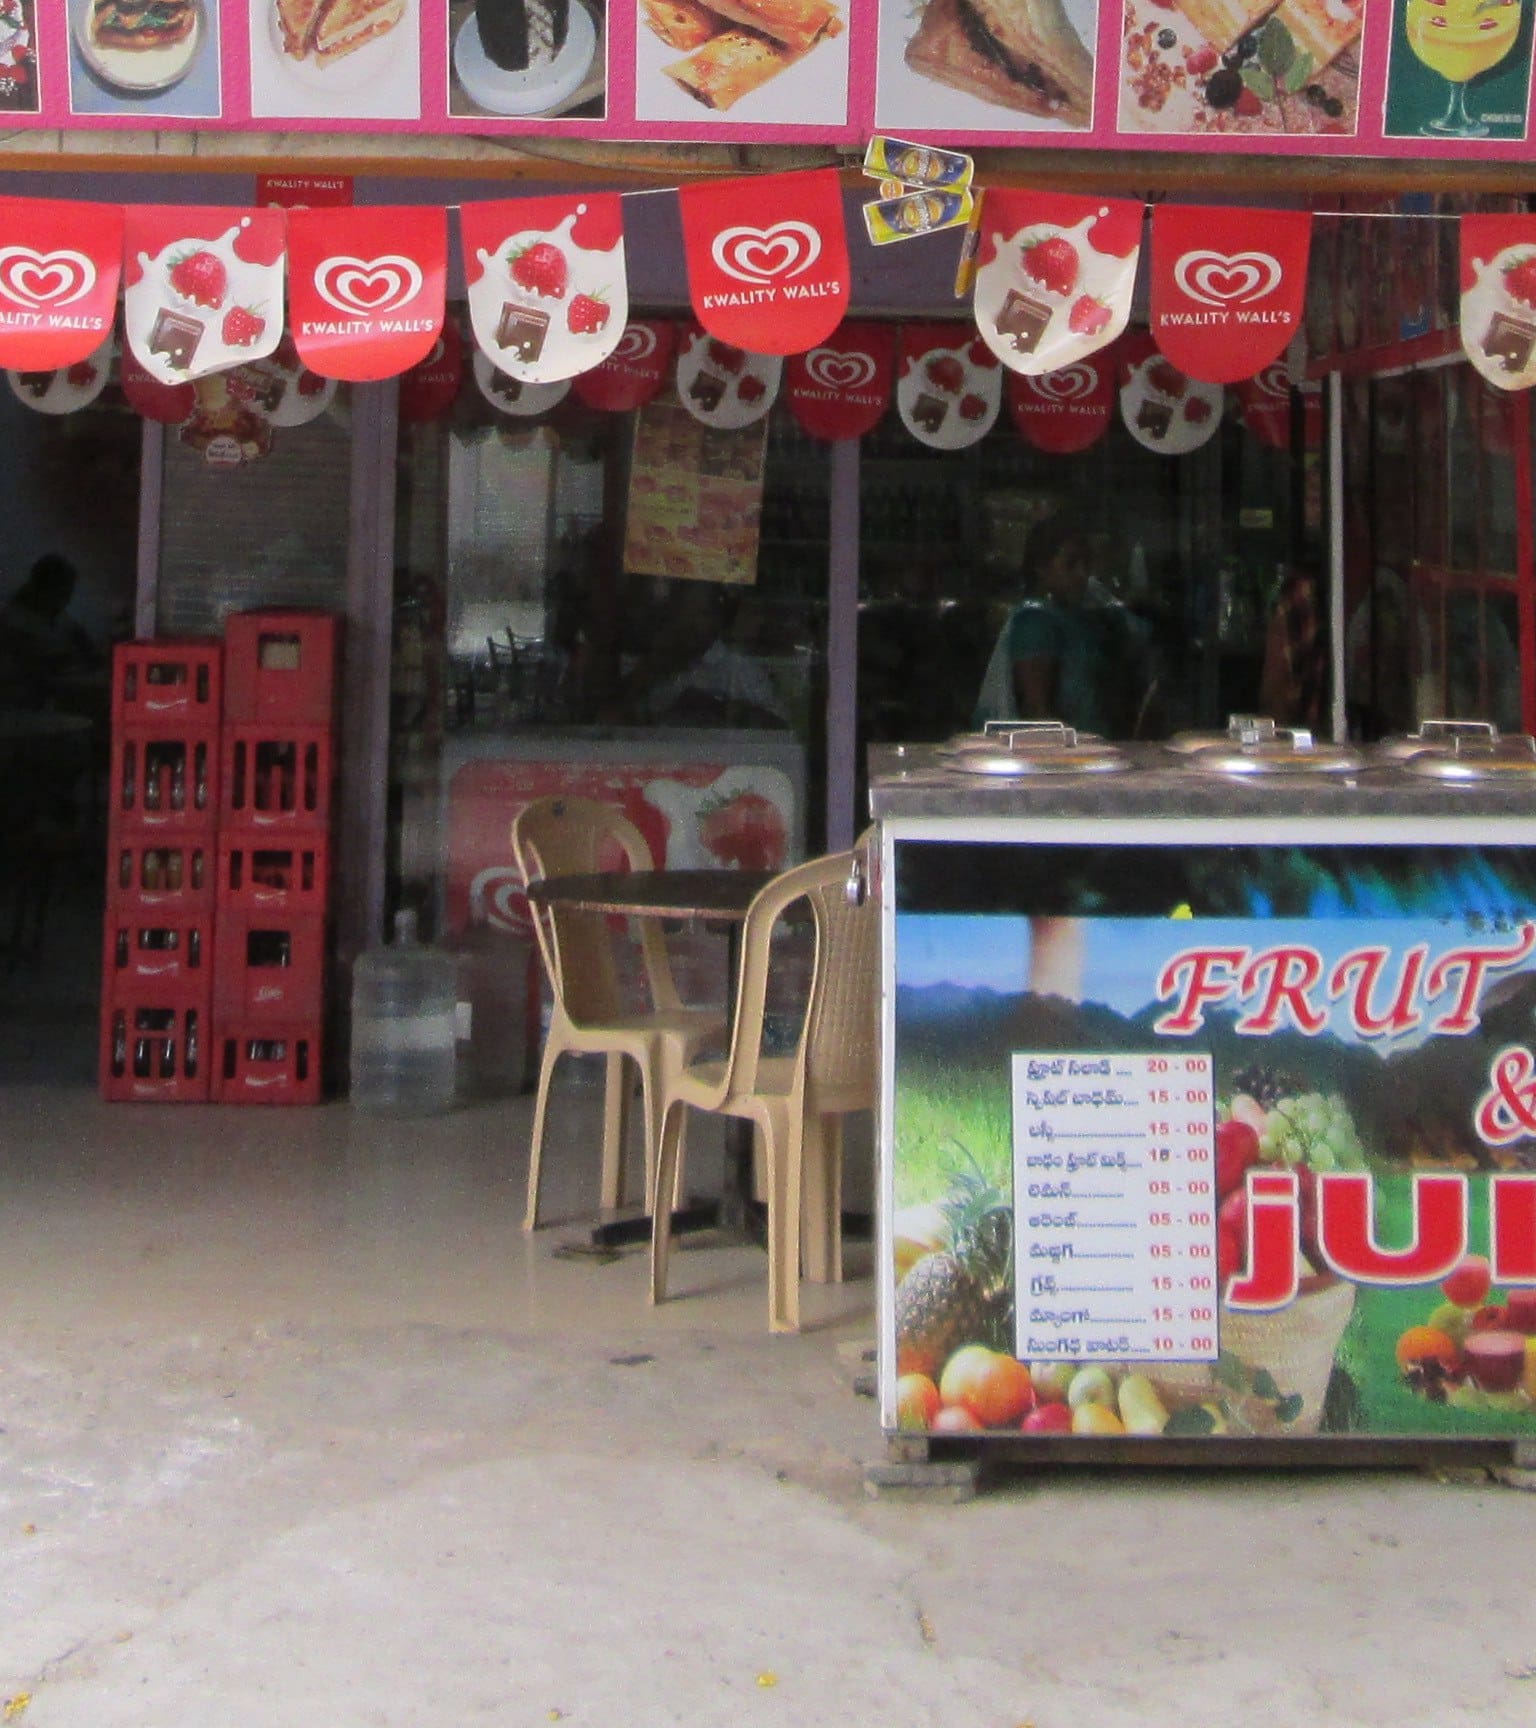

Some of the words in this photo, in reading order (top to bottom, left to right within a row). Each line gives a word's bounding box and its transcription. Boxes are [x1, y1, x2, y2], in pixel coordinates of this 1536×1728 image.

[703, 288, 776, 310] KWALITY
[782, 280, 841, 300] WALL'S
[48, 314, 103, 330] WALL'S
[1160, 312, 1230, 327] KWALITY
[1236, 311, 1292, 324] WALL'S
[302, 321, 373, 336] KWALITY
[380, 319, 434, 333] WALL'S
